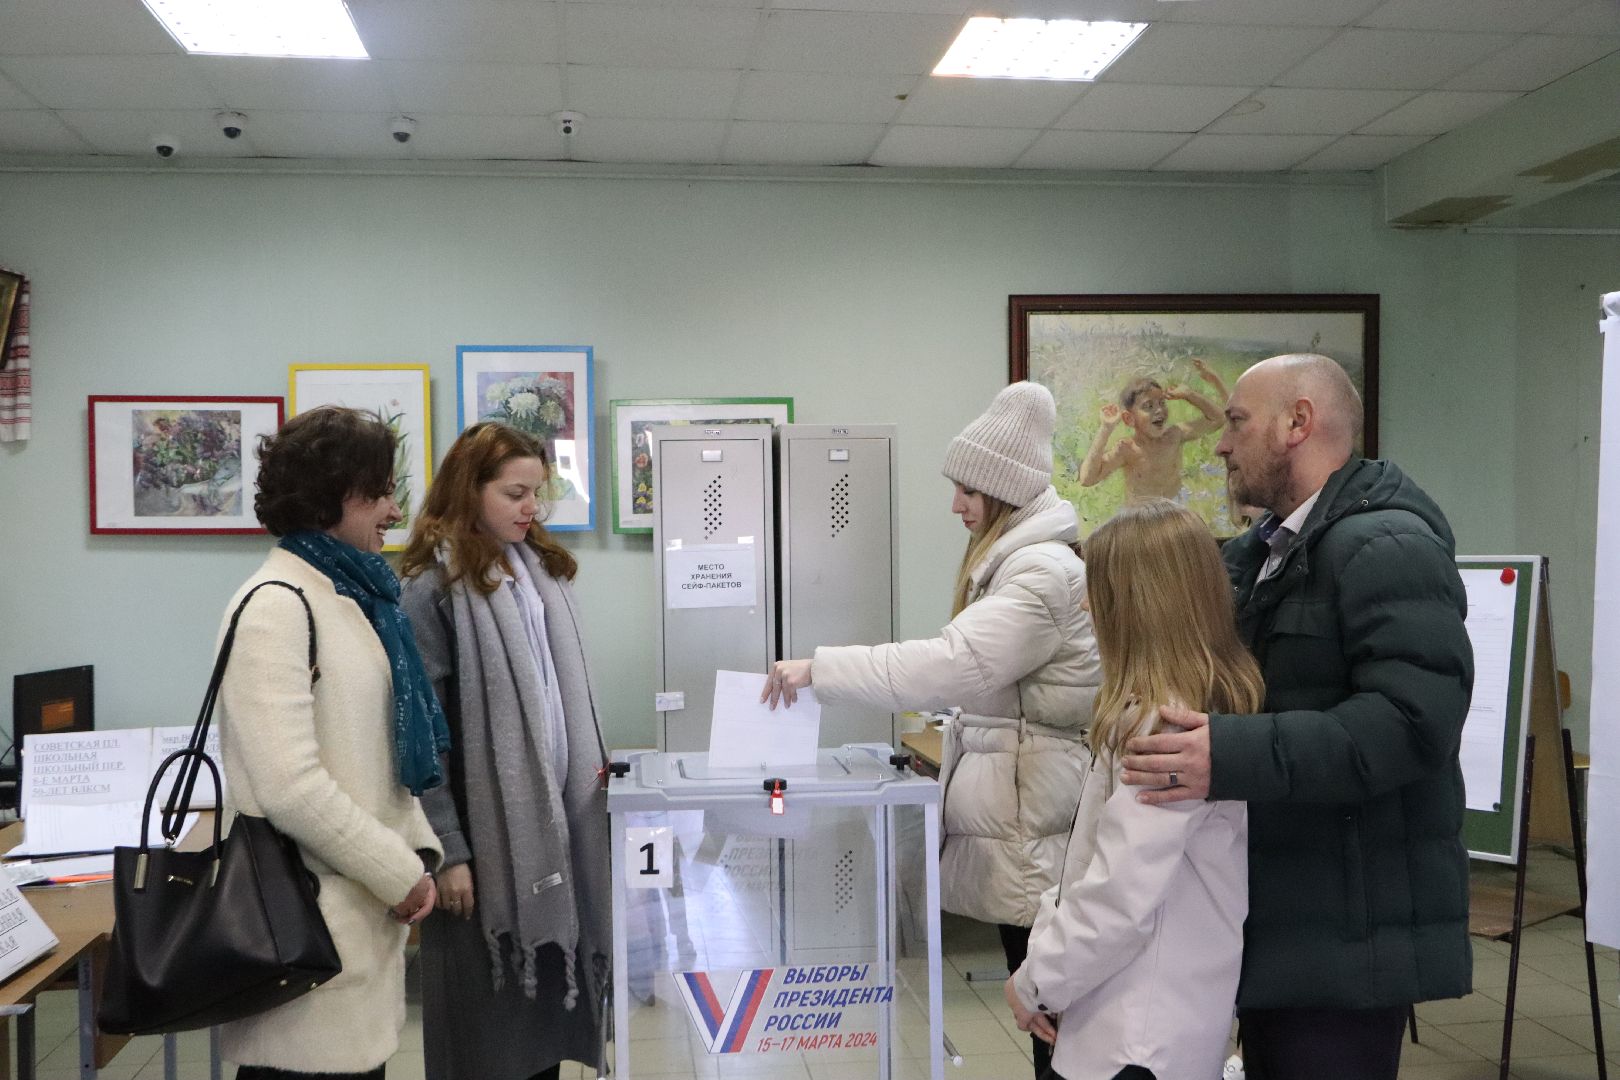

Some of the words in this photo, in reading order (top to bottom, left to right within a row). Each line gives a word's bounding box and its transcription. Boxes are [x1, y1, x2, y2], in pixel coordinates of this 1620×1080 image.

[681, 582, 742, 590] СЕЙФ-ПАКЕТОВ
[34, 740, 100, 751] СОВЕТСКАЯ
[34, 752, 97, 763] ШКОЛЬНАЯ
[33, 763, 100, 774] ШКОЛЬНЫЙ
[51, 775, 90, 784] МАРТА
[71, 784, 110, 793] ВЛКСМ
[640, 842, 660, 875] 1
[783, 964, 869, 985] ВЫБОРЫ
[773, 986, 894, 1008] ПРЕЗИДЕНТА
[764, 1012, 842, 1032] РОССИИ
[796, 1034, 842, 1050] МАРТА
[844, 1031, 877, 1048] 2024
